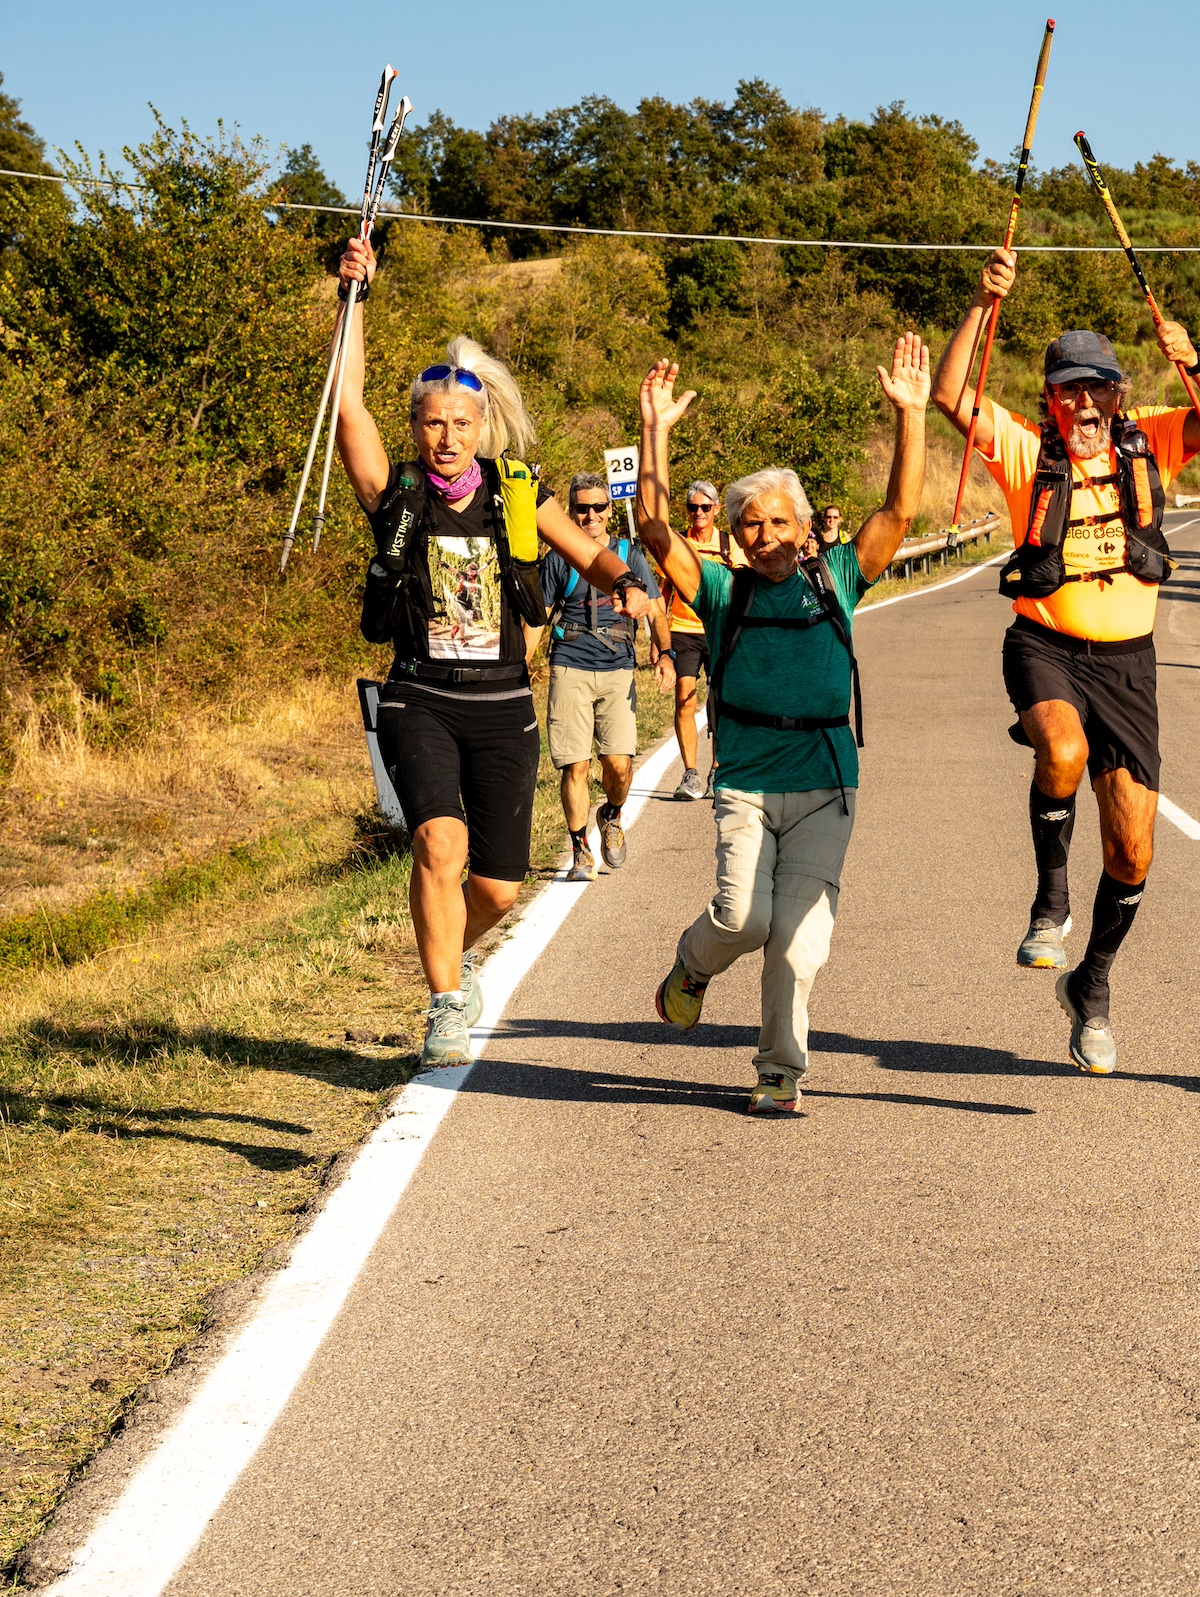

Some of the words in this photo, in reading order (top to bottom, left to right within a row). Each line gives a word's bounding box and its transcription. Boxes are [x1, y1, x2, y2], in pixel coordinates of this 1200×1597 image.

[374, 92, 384, 114] LEKI
[388, 123, 400, 145] LEKI
[1008, 203, 1019, 233] LEKI
[611, 457, 634, 473] 28
[612, 485, 623, 496] SP
[1066, 527, 1091, 540] eteo
